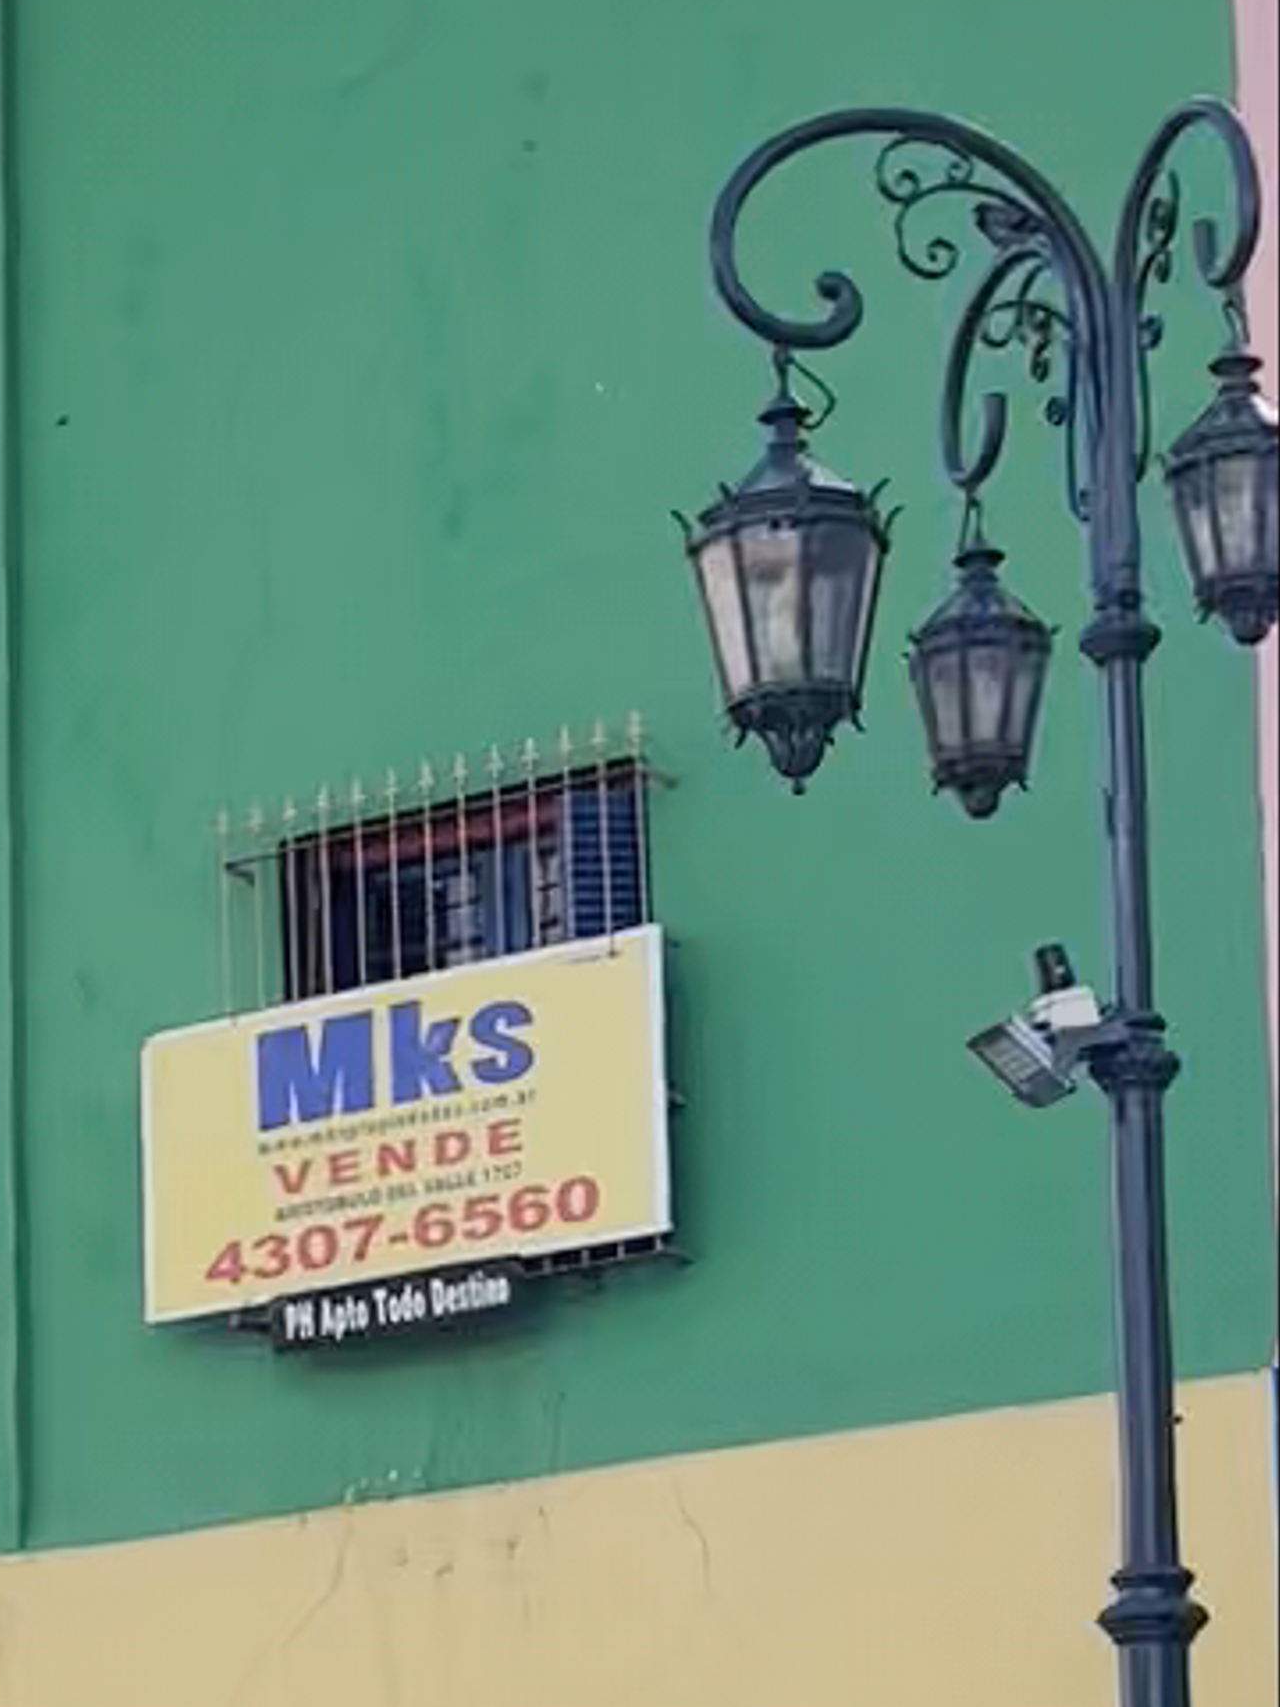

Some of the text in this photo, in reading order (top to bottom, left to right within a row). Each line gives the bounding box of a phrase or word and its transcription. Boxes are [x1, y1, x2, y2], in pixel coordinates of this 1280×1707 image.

[257, 999, 535, 1132] Mks
[275, 1118, 523, 1194] VENDE
[204, 1175, 601, 1286] 4307-6560
[285, 1271, 511, 1341] PH Apto Todo Destino
